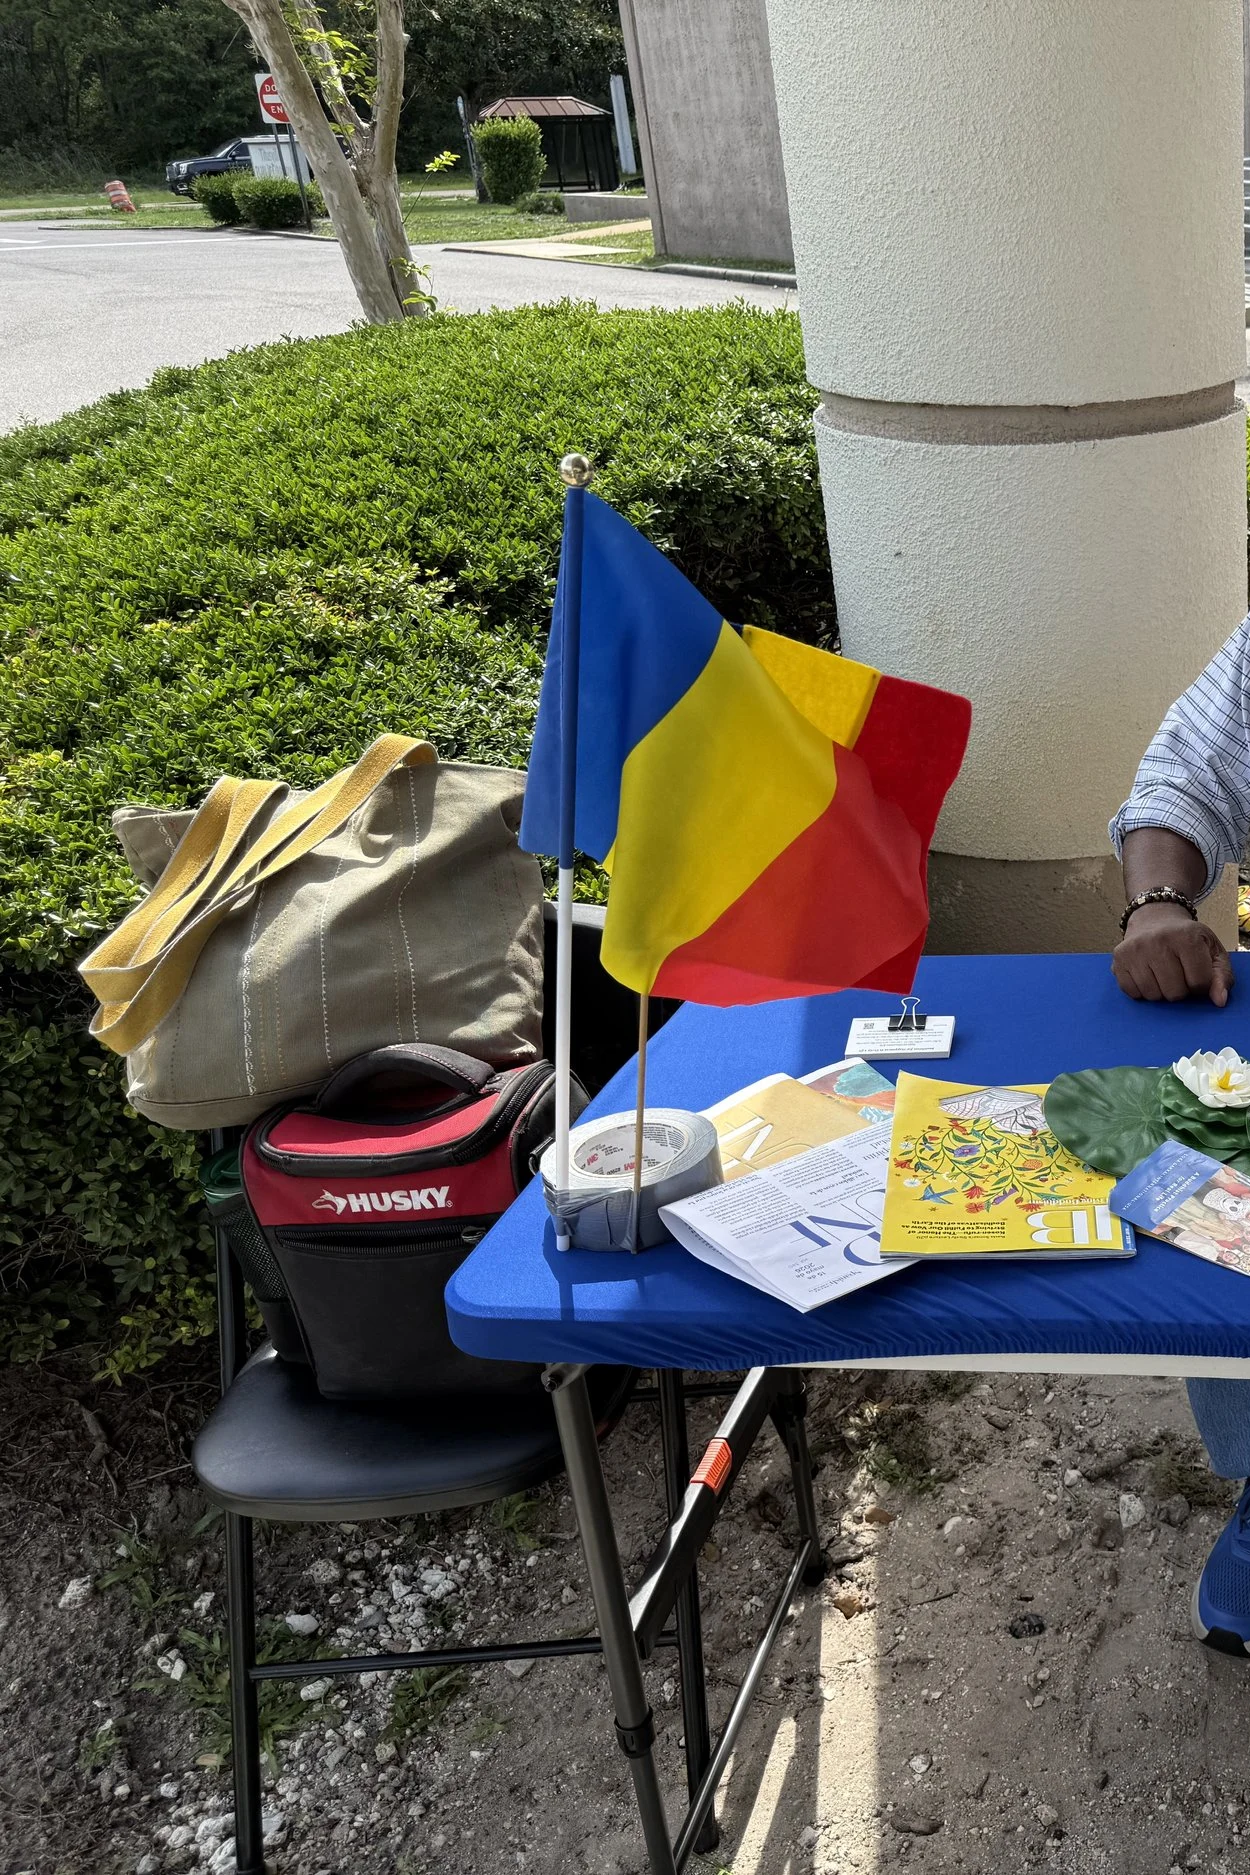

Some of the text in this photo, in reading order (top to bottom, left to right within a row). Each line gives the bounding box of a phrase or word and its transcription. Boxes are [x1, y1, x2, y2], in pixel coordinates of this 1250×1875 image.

[265, 84, 277, 92] DO
[270, 105, 284, 114] EN
[587, 1154, 598, 1166] 3M
[1155, 1175, 1185, 1203] for Real Life
[1172, 1175, 1196, 1195] Buddhist
[346, 1185, 450, 1213] HUSKY
[1028, 1198, 1079, 1206] Buddhism
[1153, 1194, 1175, 1213] Practice
